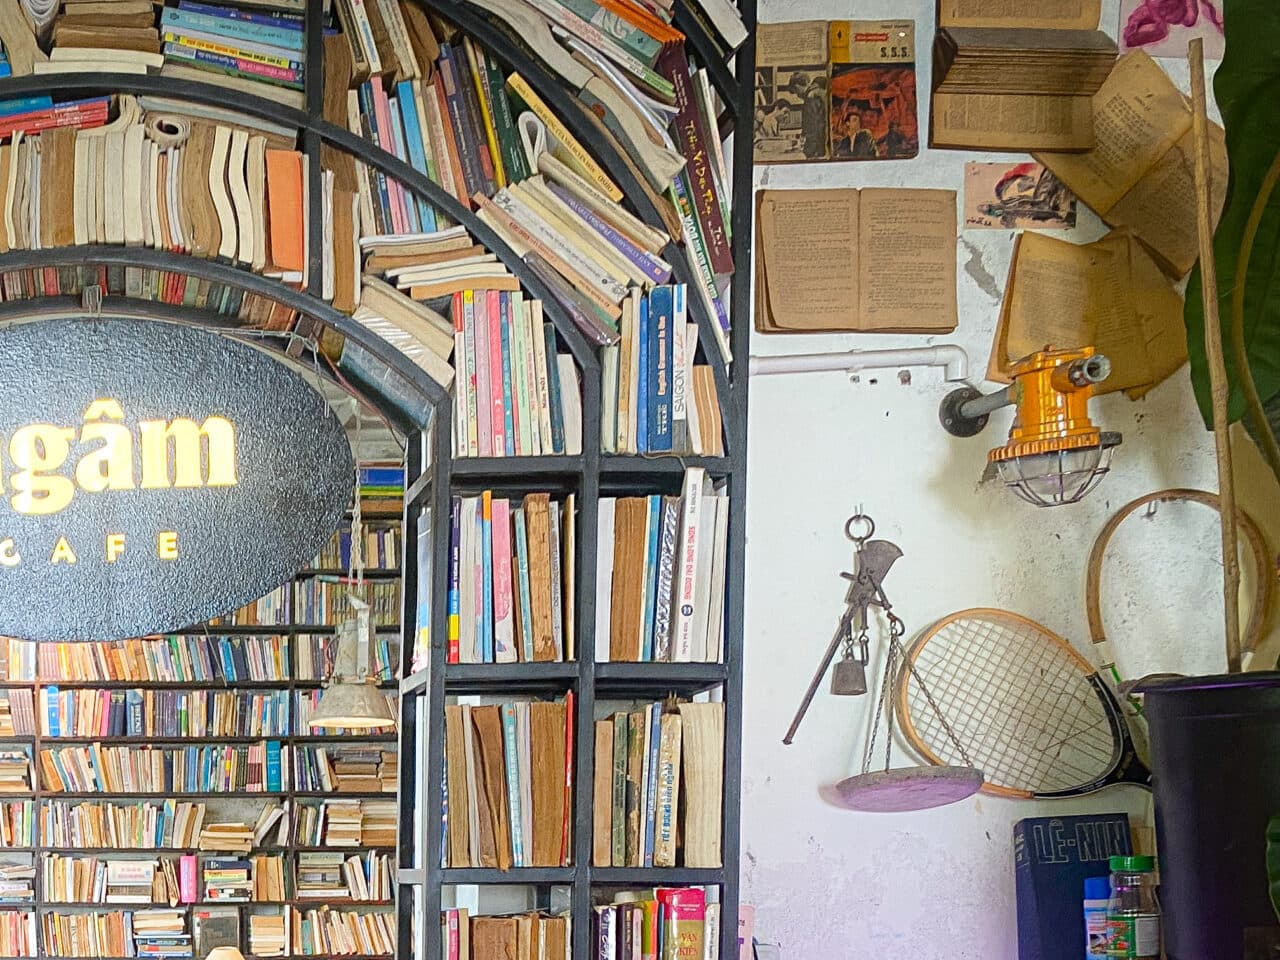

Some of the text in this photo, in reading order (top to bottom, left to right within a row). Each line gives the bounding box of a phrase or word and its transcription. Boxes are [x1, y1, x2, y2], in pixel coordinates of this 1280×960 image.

[880, 46, 910, 58] S.S.S.
[683, 214, 698, 239] BOYA
[657, 316, 666, 329] Use
[657, 330, 666, 338] in
[657, 370, 668, 396] English
[673, 370, 685, 413] SAIGON
